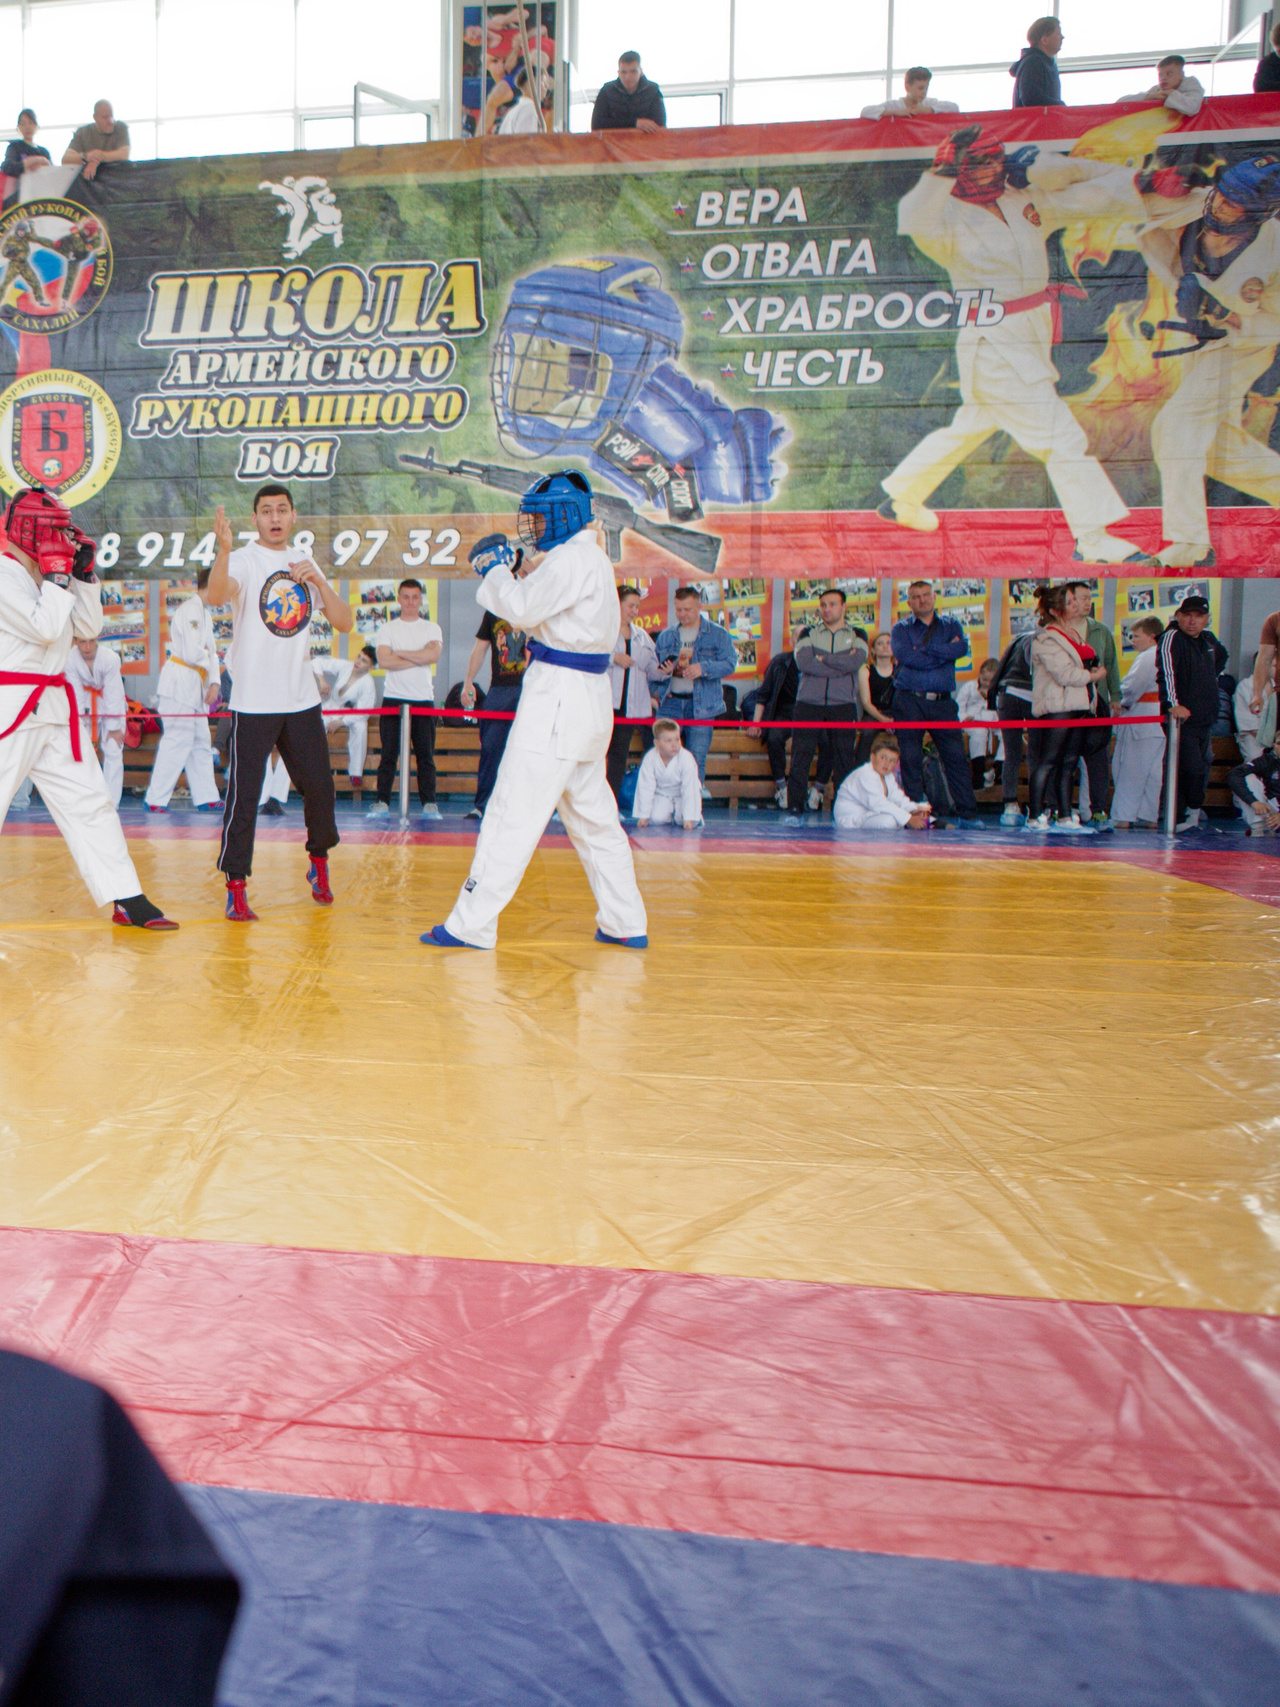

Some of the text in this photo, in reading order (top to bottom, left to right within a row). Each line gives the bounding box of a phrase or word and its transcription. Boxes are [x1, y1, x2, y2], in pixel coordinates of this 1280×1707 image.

[695, 186, 809, 227] ВЕРА
[93, 259, 107, 287] БОЙ
[701, 238, 878, 280] ОТВАГА
[12, 310, 80, 330] САХАЛИН
[143, 260, 486, 345] ШКОЛА
[719, 288, 1006, 335] ХРАБРОСТЬ
[163, 341, 455, 389] АРМЕЙСКОГО
[742, 347, 884, 387] ЧЕСТЬ
[77, 378, 107, 405] КЛУБ
[131, 387, 468, 435] РУКОПАШНОГО
[36, 409, 69, 452] Б
[604, 432, 641, 462] РЭЙ
[239, 438, 337, 478] БОЯ
[670, 480, 694, 509] СПОРТ
[95, 531, 121, 569] 8
[137, 530, 216, 568] 914
[237, 529, 315, 558] 78
[332, 529, 390, 568] 97
[402, 527, 462, 567] 32
[631, 613, 661, 629] 024
